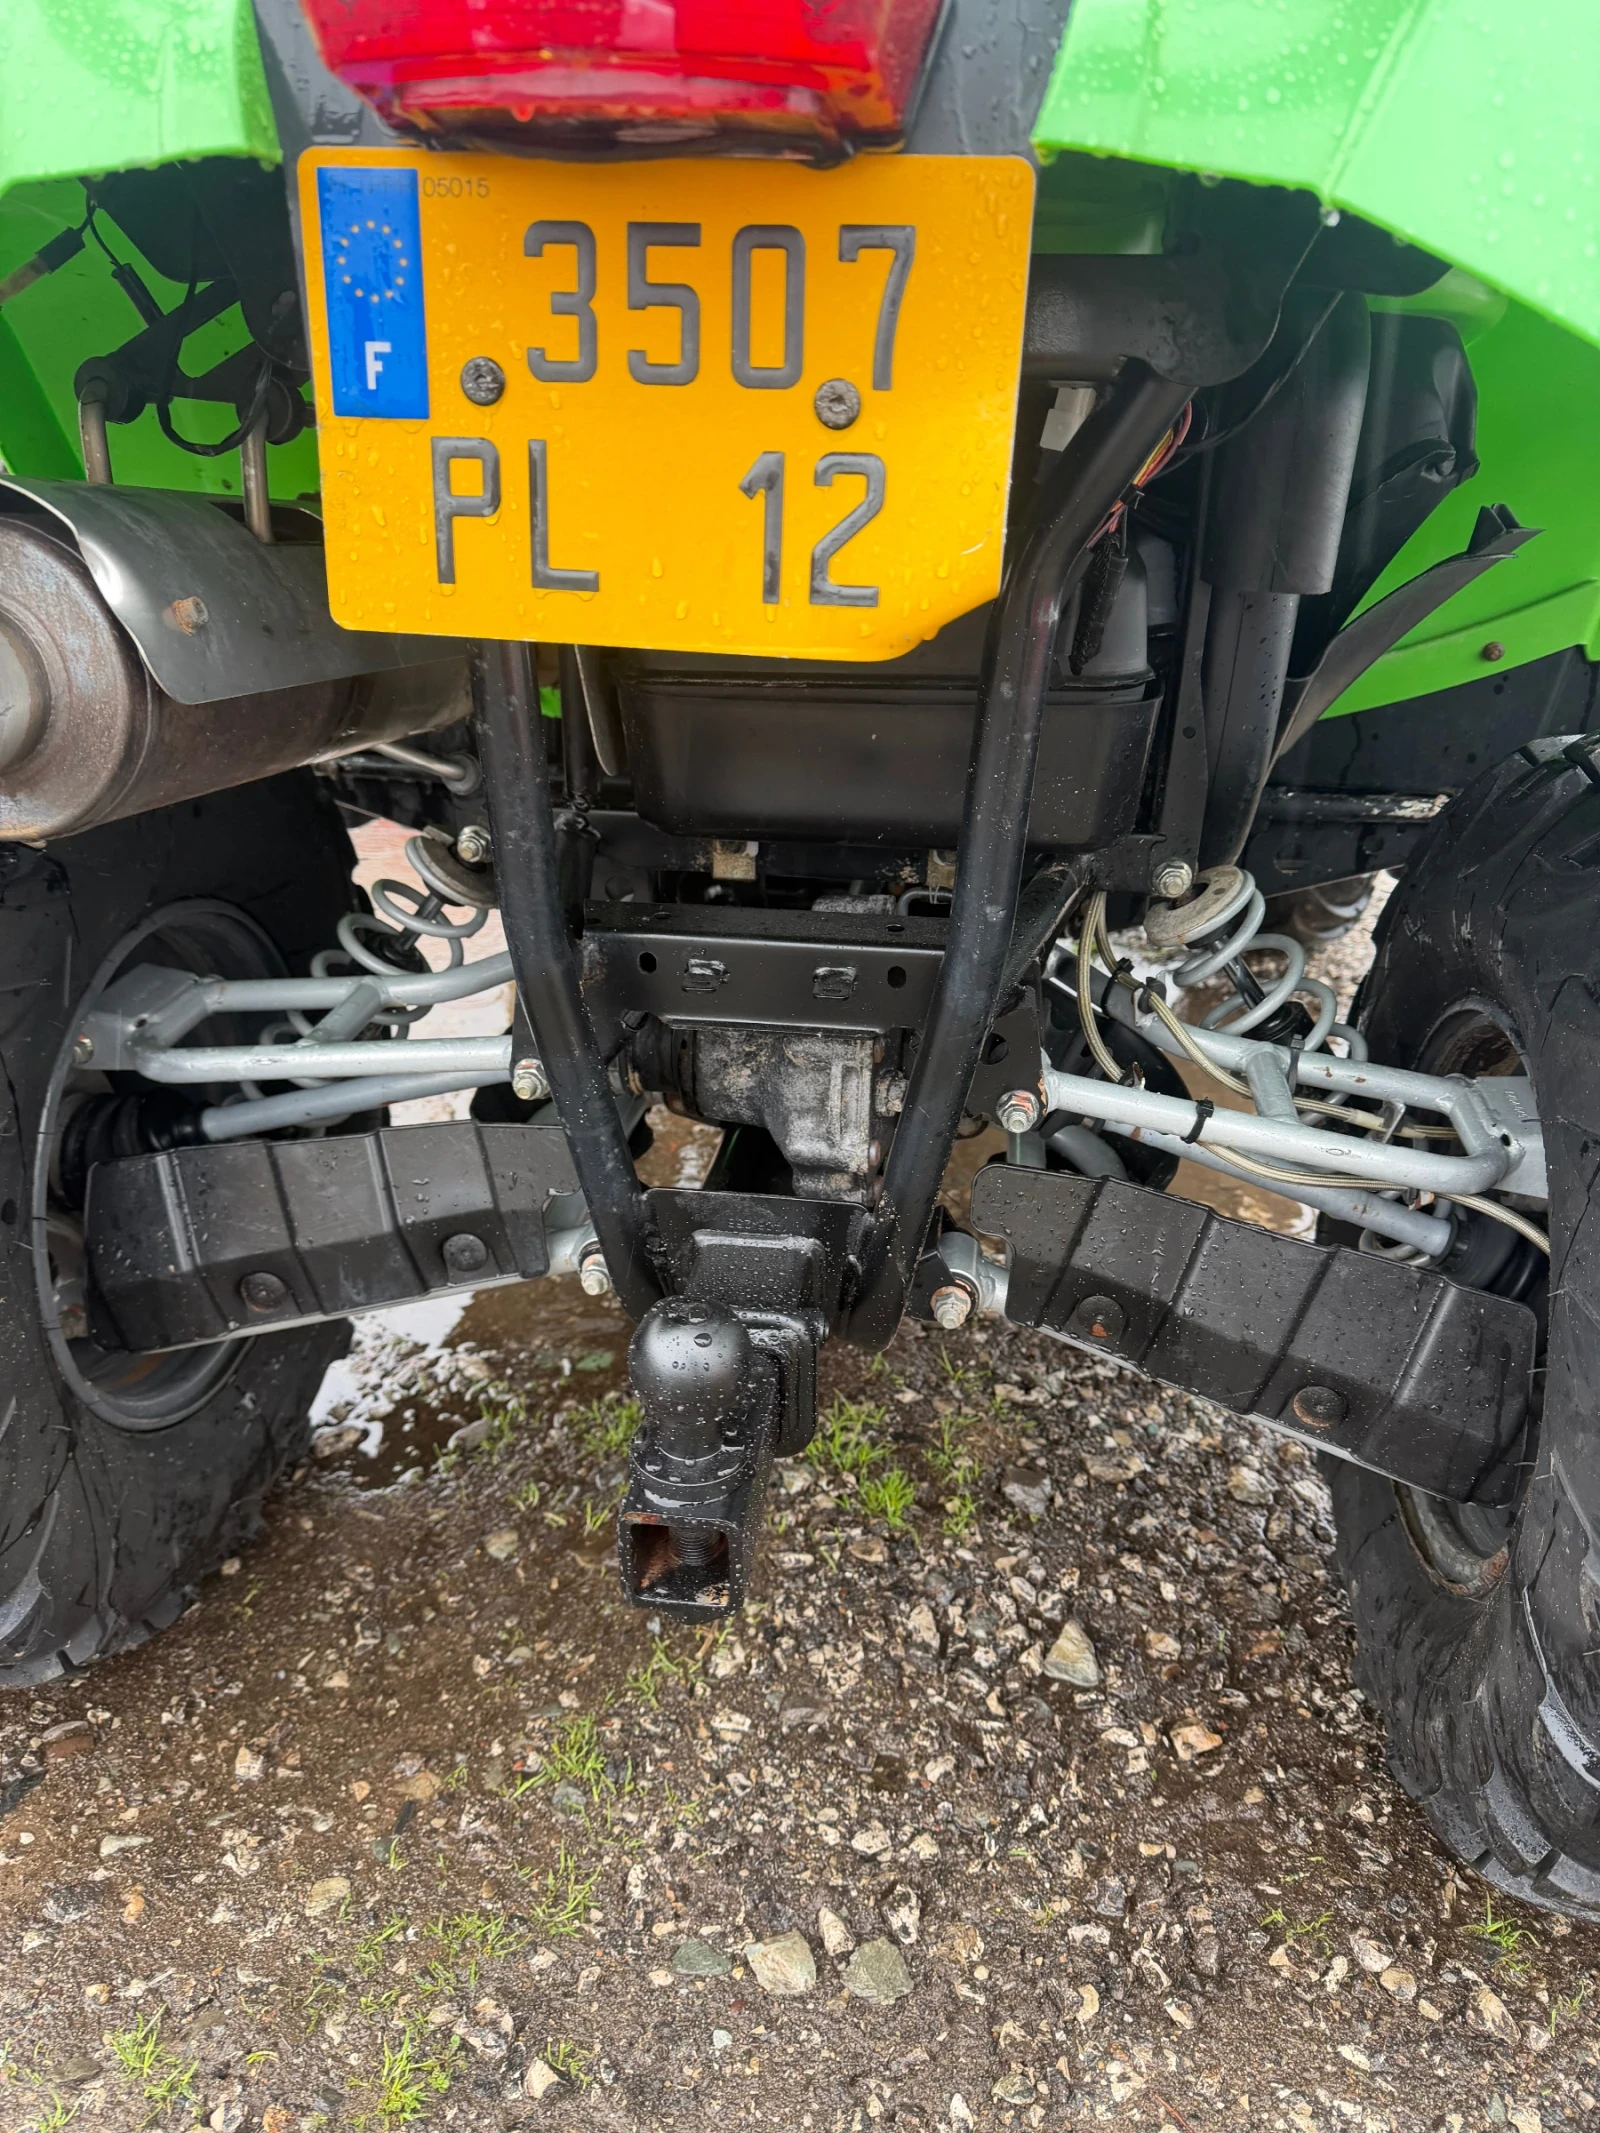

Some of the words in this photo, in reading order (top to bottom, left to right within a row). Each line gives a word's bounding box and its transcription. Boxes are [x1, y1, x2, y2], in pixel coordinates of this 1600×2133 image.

[422, 176, 490, 198] 05015
[524, 220, 915, 391] 3507
[364, 340, 392, 390] F
[431, 437, 599, 593] PL
[739, 452, 885, 607] 12
